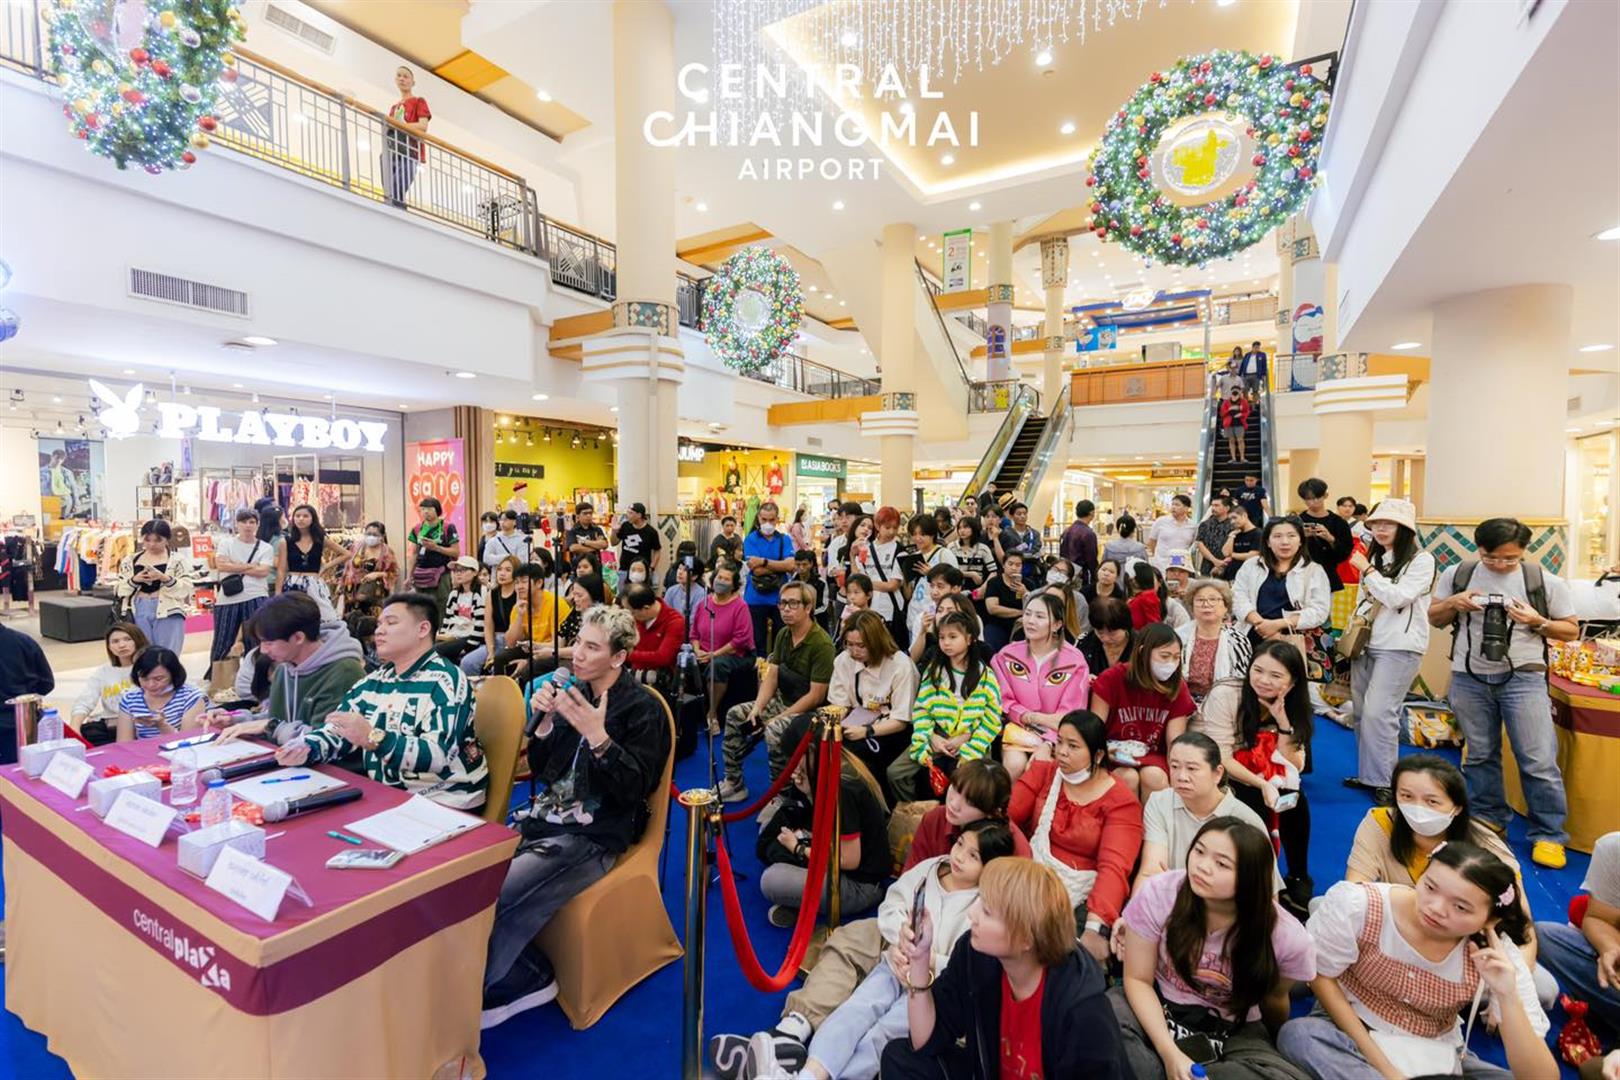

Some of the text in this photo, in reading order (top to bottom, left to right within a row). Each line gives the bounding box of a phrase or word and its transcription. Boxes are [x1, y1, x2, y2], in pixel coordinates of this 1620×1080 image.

[157, 402, 388, 452] PLAYBOY
[416, 451, 455, 467] HAPPY
[678, 447, 705, 462] JUMP
[412, 477, 460, 497] sale
